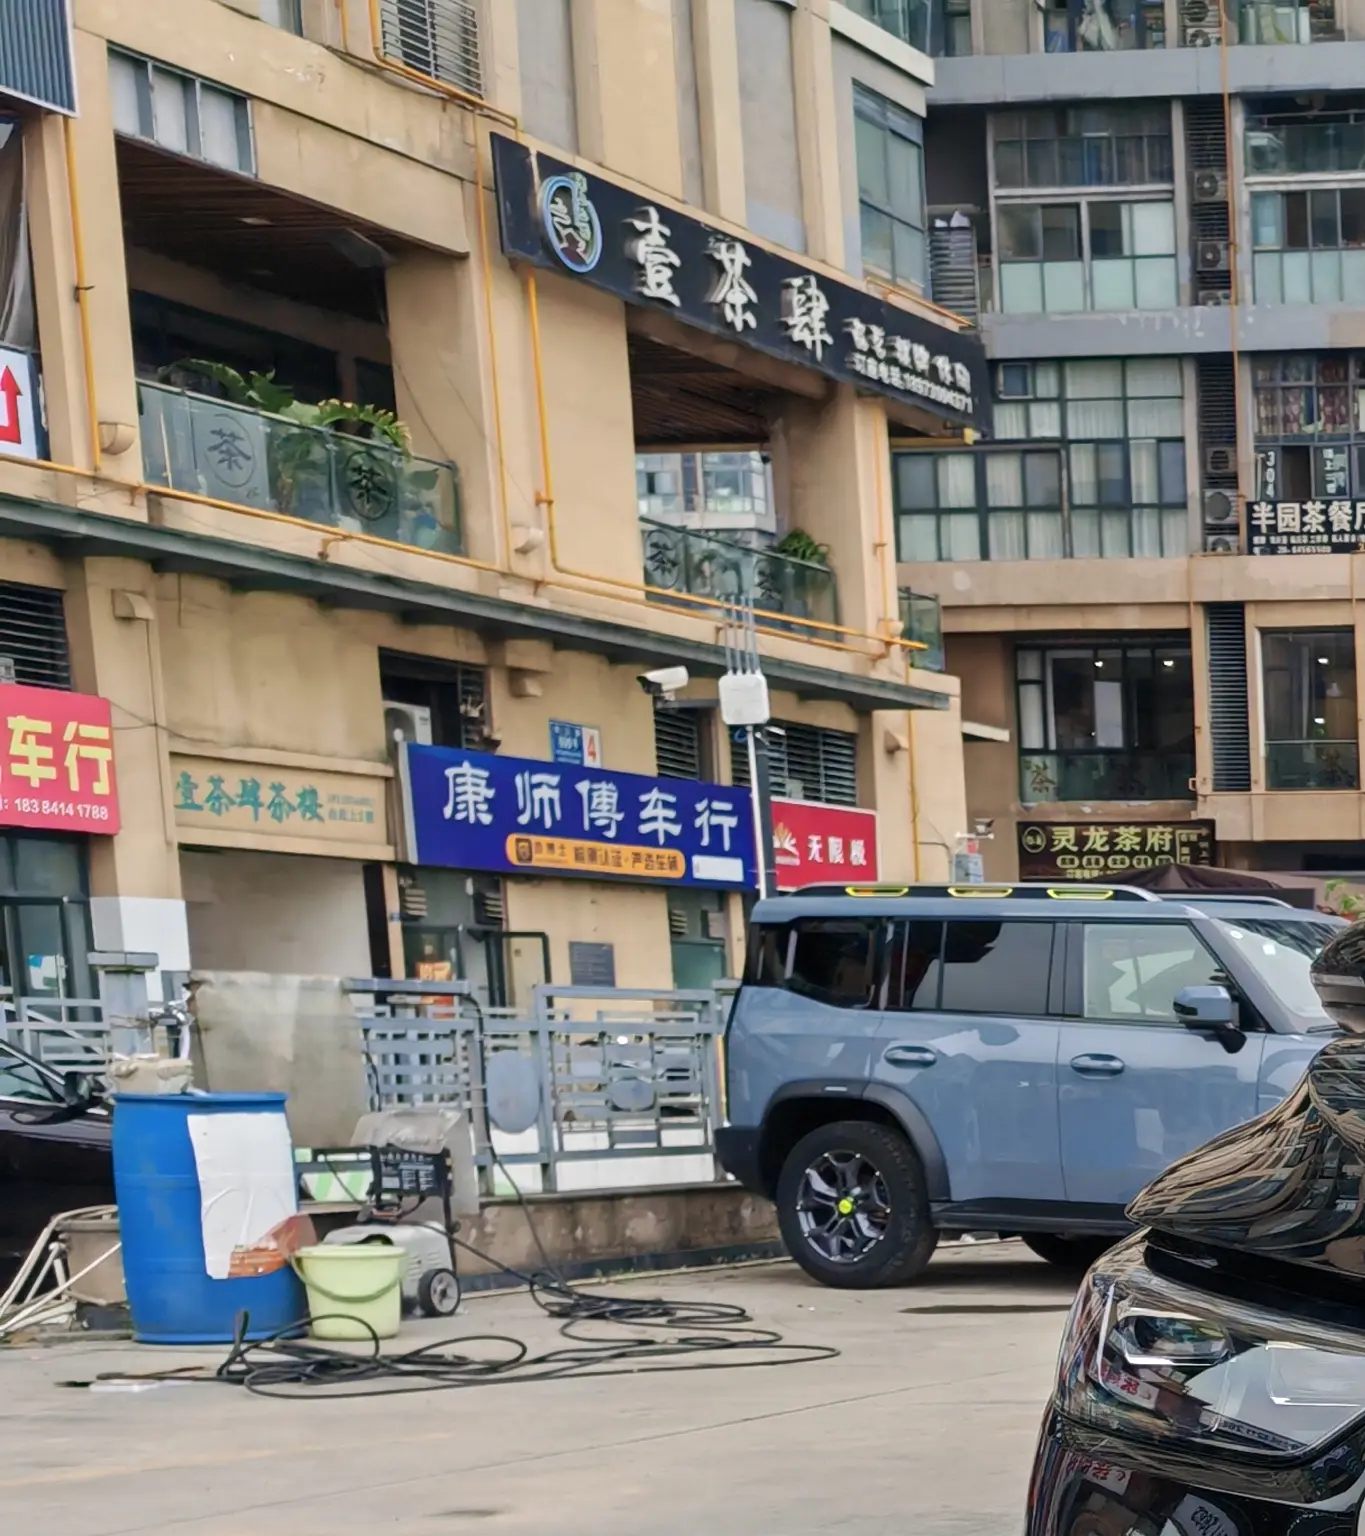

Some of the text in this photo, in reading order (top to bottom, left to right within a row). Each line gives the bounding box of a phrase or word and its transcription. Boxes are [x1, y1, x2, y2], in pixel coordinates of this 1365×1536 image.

[628, 206, 834, 362] 壹茶肆
[207, 428, 252, 471] 茶
[350, 464, 389, 510] 茶
[0, 714, 113, 796] 车行
[14, 797, 40, 814] 183
[443, 759, 739, 853] 康师傅车行
[1050, 825, 1173, 852] 灵龙茶府
